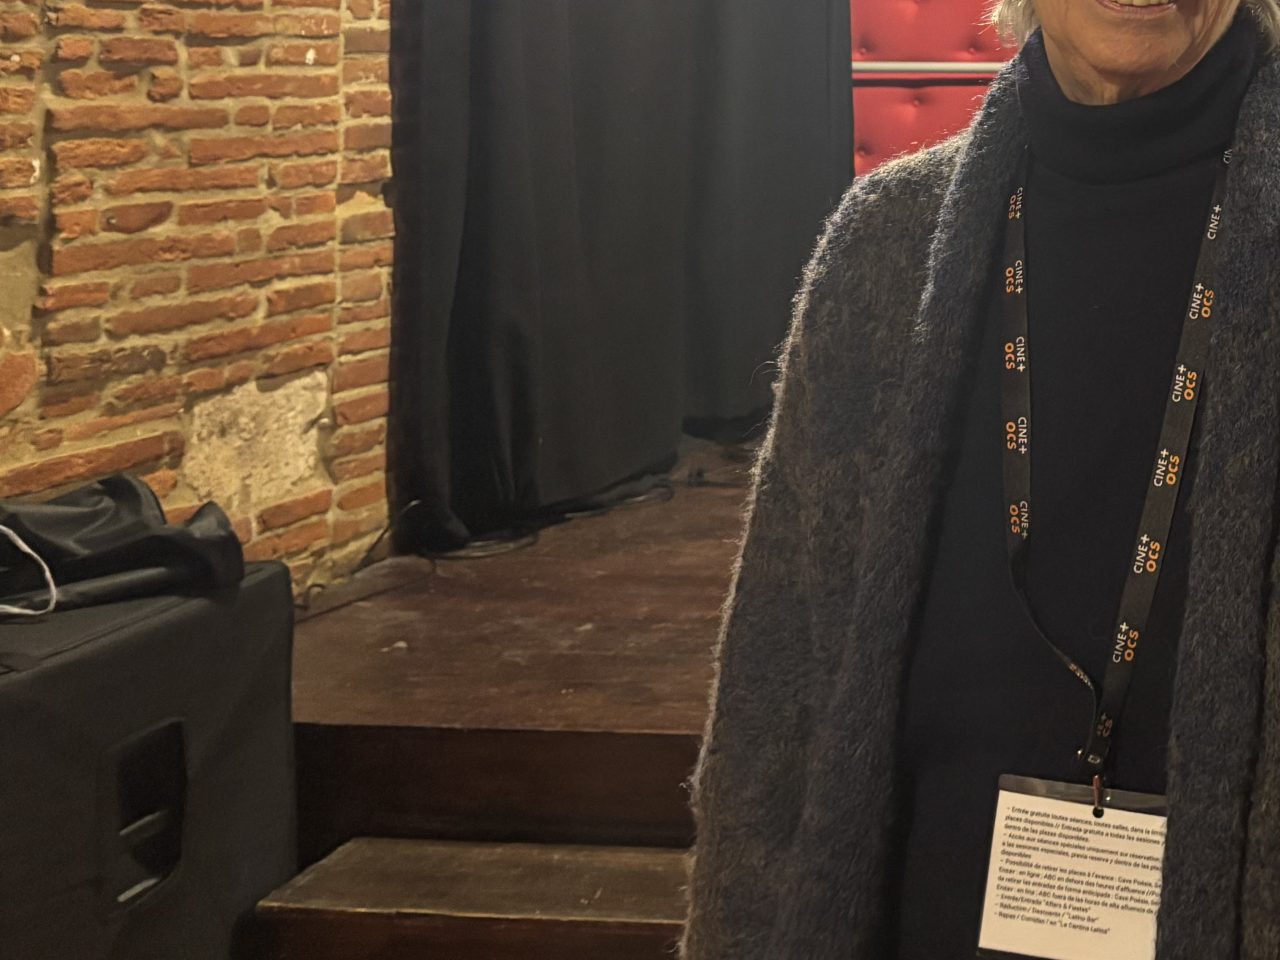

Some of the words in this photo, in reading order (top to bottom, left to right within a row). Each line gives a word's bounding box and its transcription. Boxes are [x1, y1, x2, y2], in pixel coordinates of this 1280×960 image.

[1006, 267, 1014, 293] OCS
[1201, 289, 1214, 318] OCS
[1005, 342, 1015, 370] OCS
[1184, 371, 1197, 400] OCS
[1006, 421, 1017, 450] OCS
[1166, 454, 1180, 485] OCS
[1009, 504, 1020, 534] OCS
[1146, 540, 1161, 572] OCS
[1125, 629, 1139, 661] OCS
